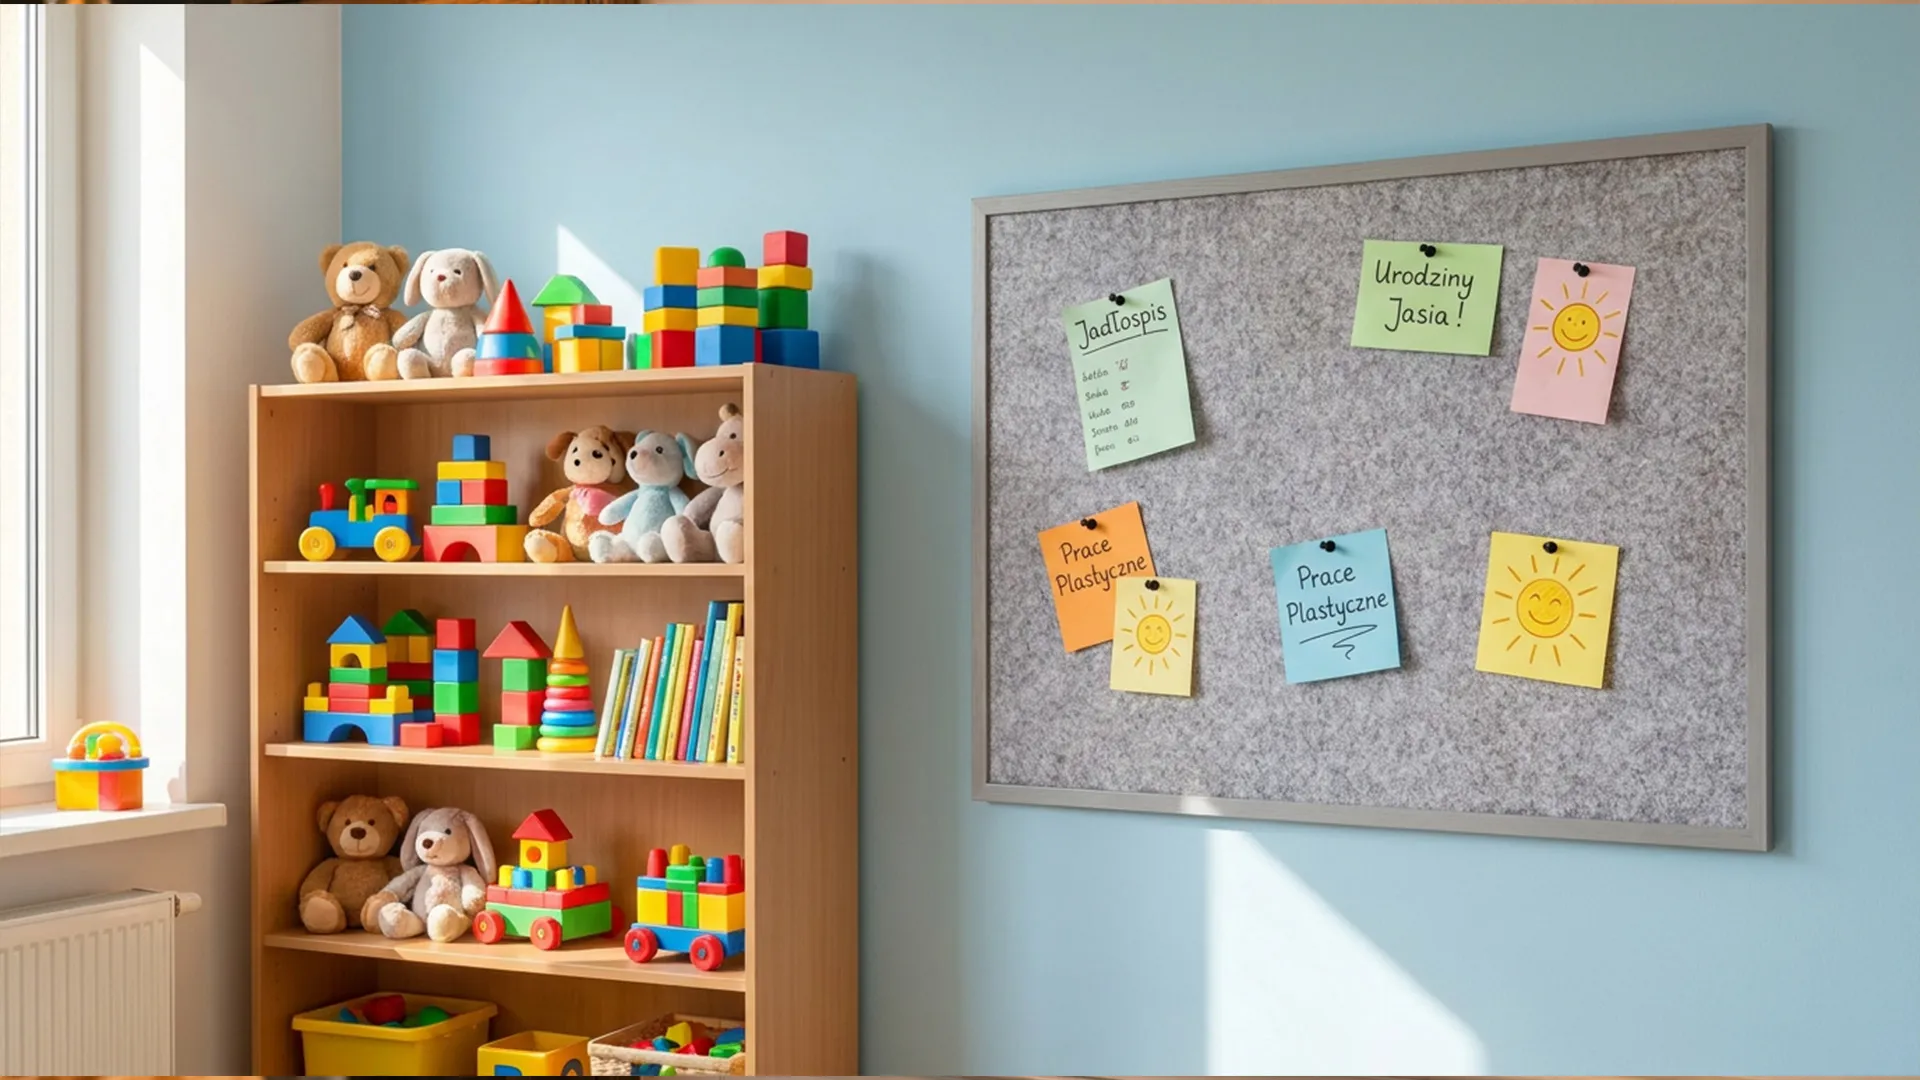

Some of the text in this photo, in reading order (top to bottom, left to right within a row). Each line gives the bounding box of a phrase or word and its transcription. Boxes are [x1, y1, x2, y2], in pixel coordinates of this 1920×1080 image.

[1375, 260, 1474, 300] Urodziny
[1060, 539, 1112, 564] Prace
[1056, 556, 1147, 596] Plastyczne
[1297, 565, 1356, 590] Prace
[1286, 593, 1388, 627] Plastyczne
